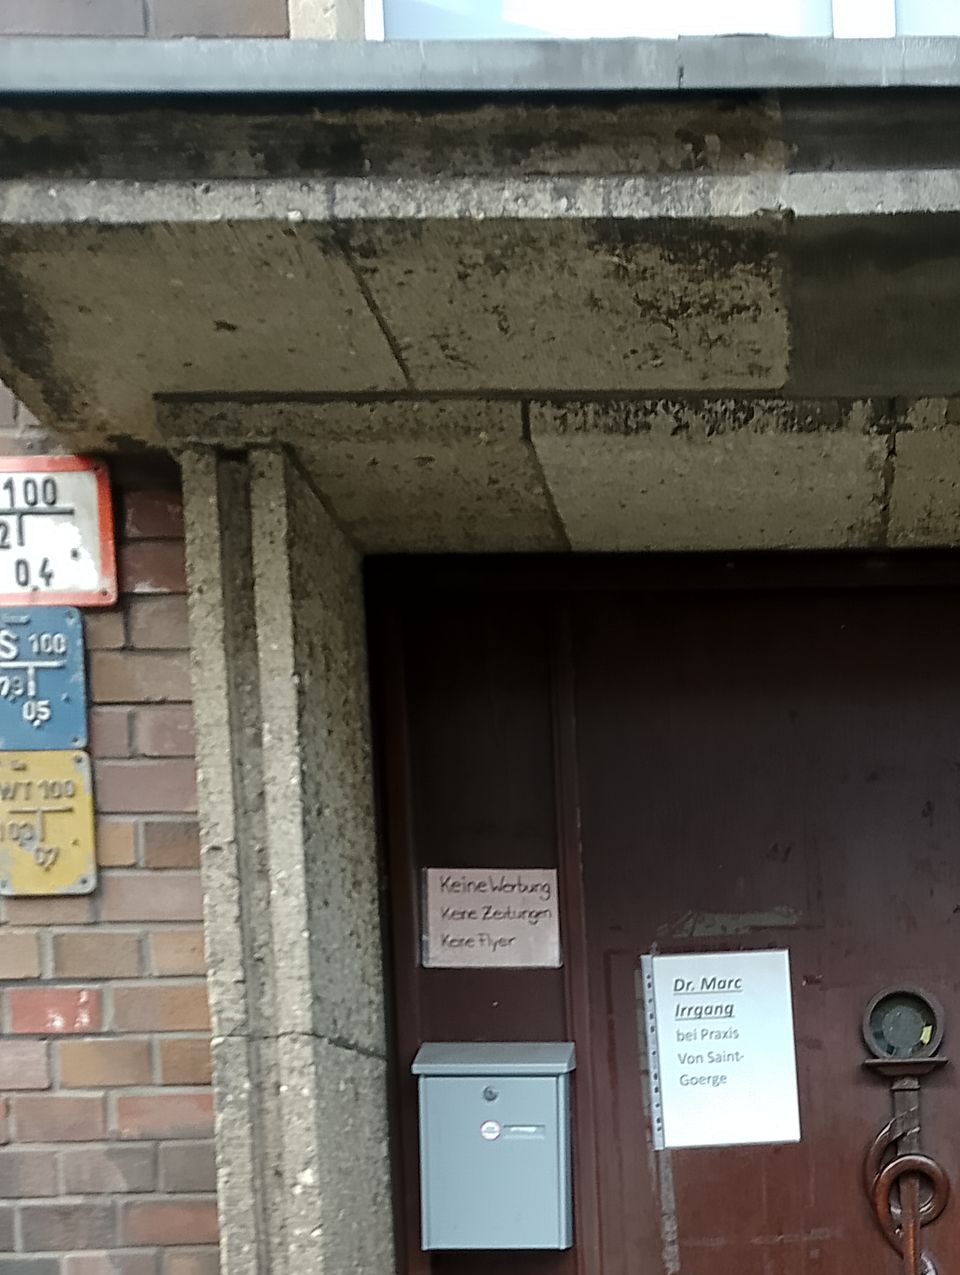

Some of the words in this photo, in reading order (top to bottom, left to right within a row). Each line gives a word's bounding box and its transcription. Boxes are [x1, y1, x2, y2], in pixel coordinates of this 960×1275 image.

[3, 476, 58, 507] 100
[28, 632, 68, 654] 100
[440, 876, 487, 893] Keine
[489, 875, 551, 901] Werbung
[477, 932, 517, 953] Flyer
[673, 978, 696, 995] Dr.
[700, 976, 743, 992] Marc
[674, 1003, 735, 1020] Irrgang
[676, 1028, 698, 1043] bei
[700, 1026, 740, 1041] Praxis
[677, 1052, 704, 1065] Von
[706, 1050, 745, 1064] Saint-
[679, 1073, 728, 1088] Goerge
